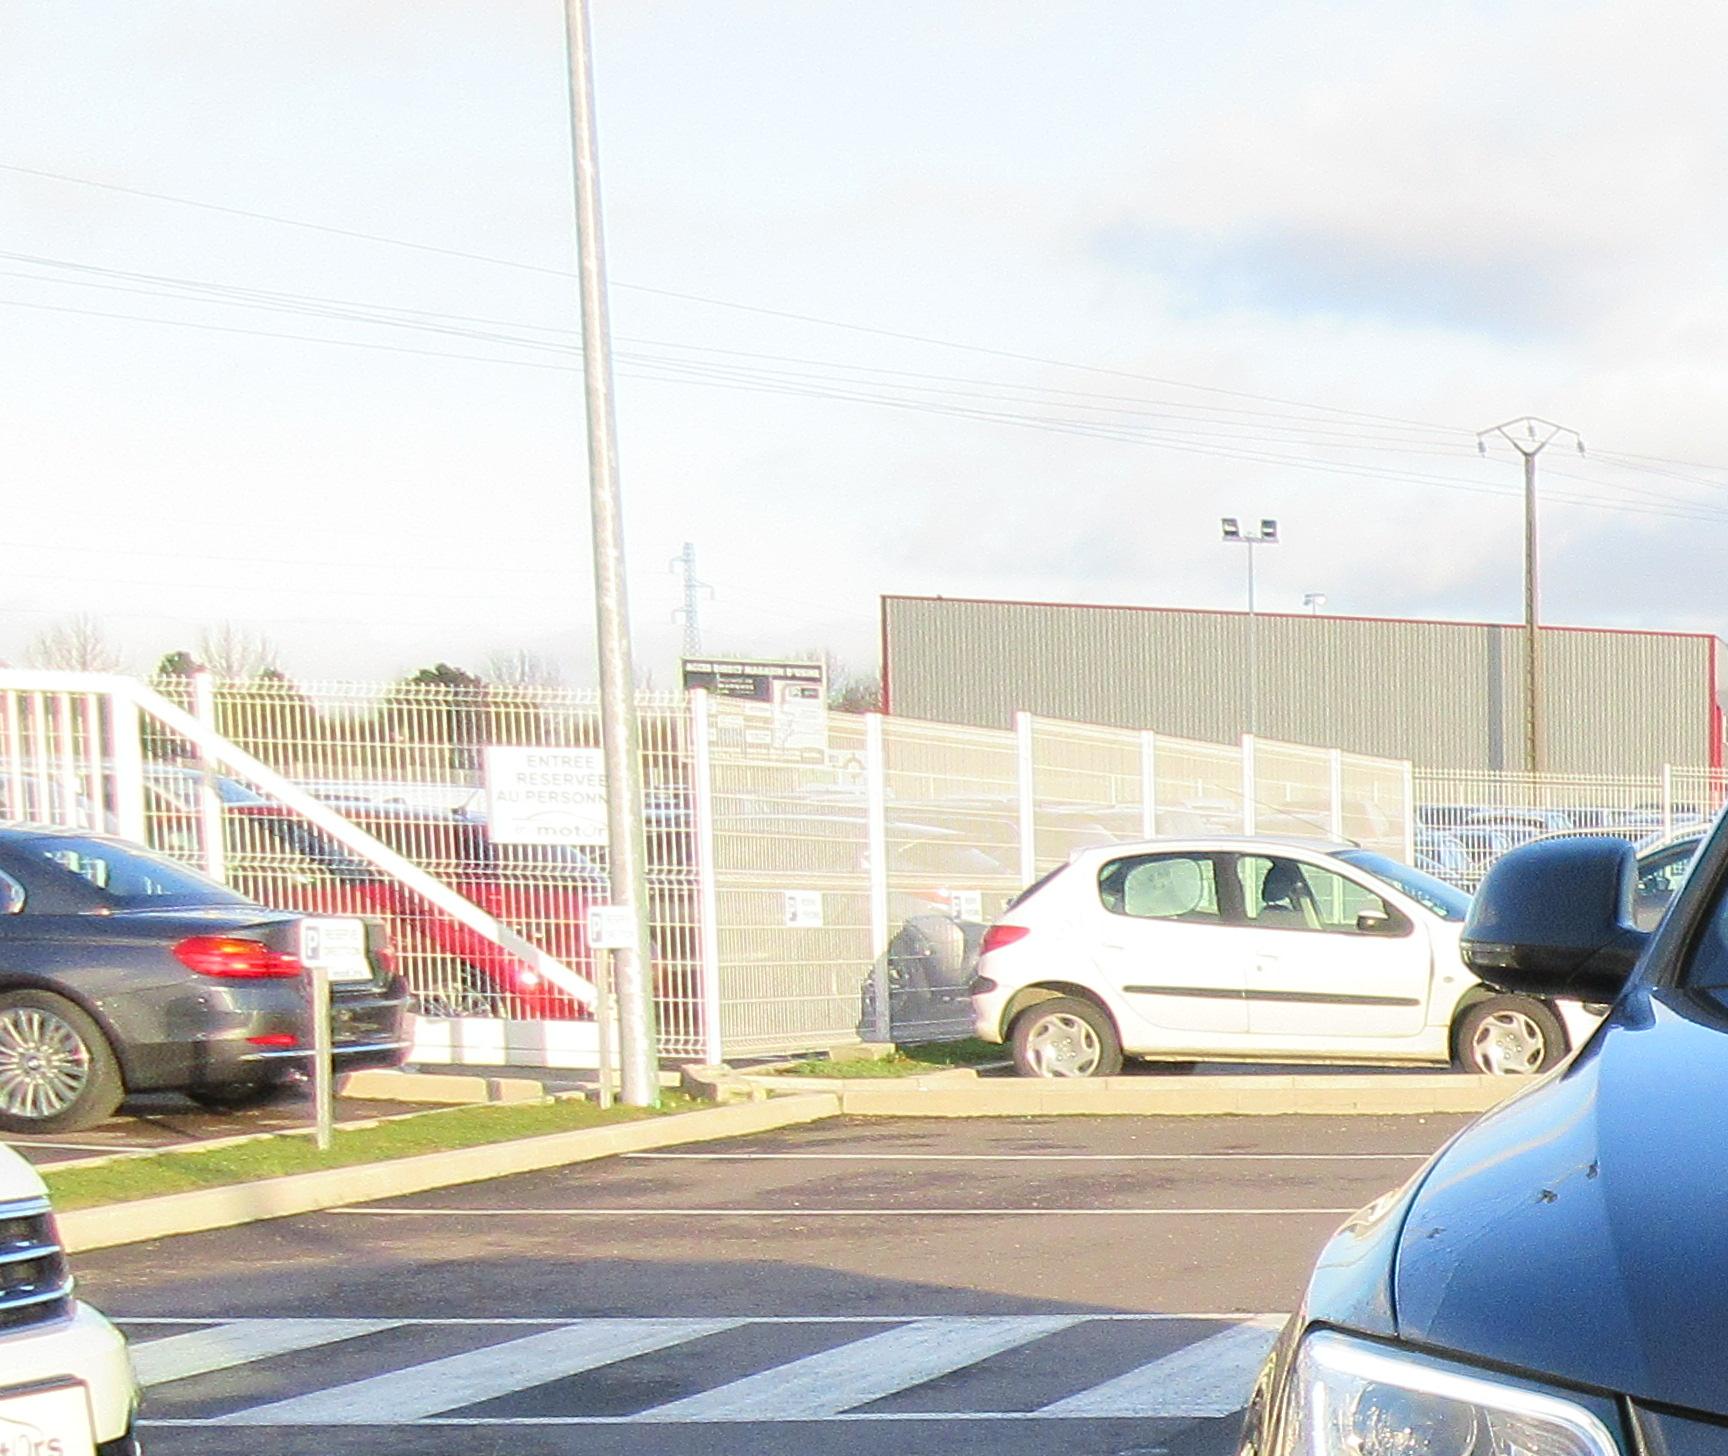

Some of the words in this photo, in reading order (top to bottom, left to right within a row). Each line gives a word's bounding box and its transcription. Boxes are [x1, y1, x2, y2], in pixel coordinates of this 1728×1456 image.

[527, 755, 595, 769] ENTREE
[497, 790, 519, 802] AU
[525, 791, 609, 804] PERSONN
